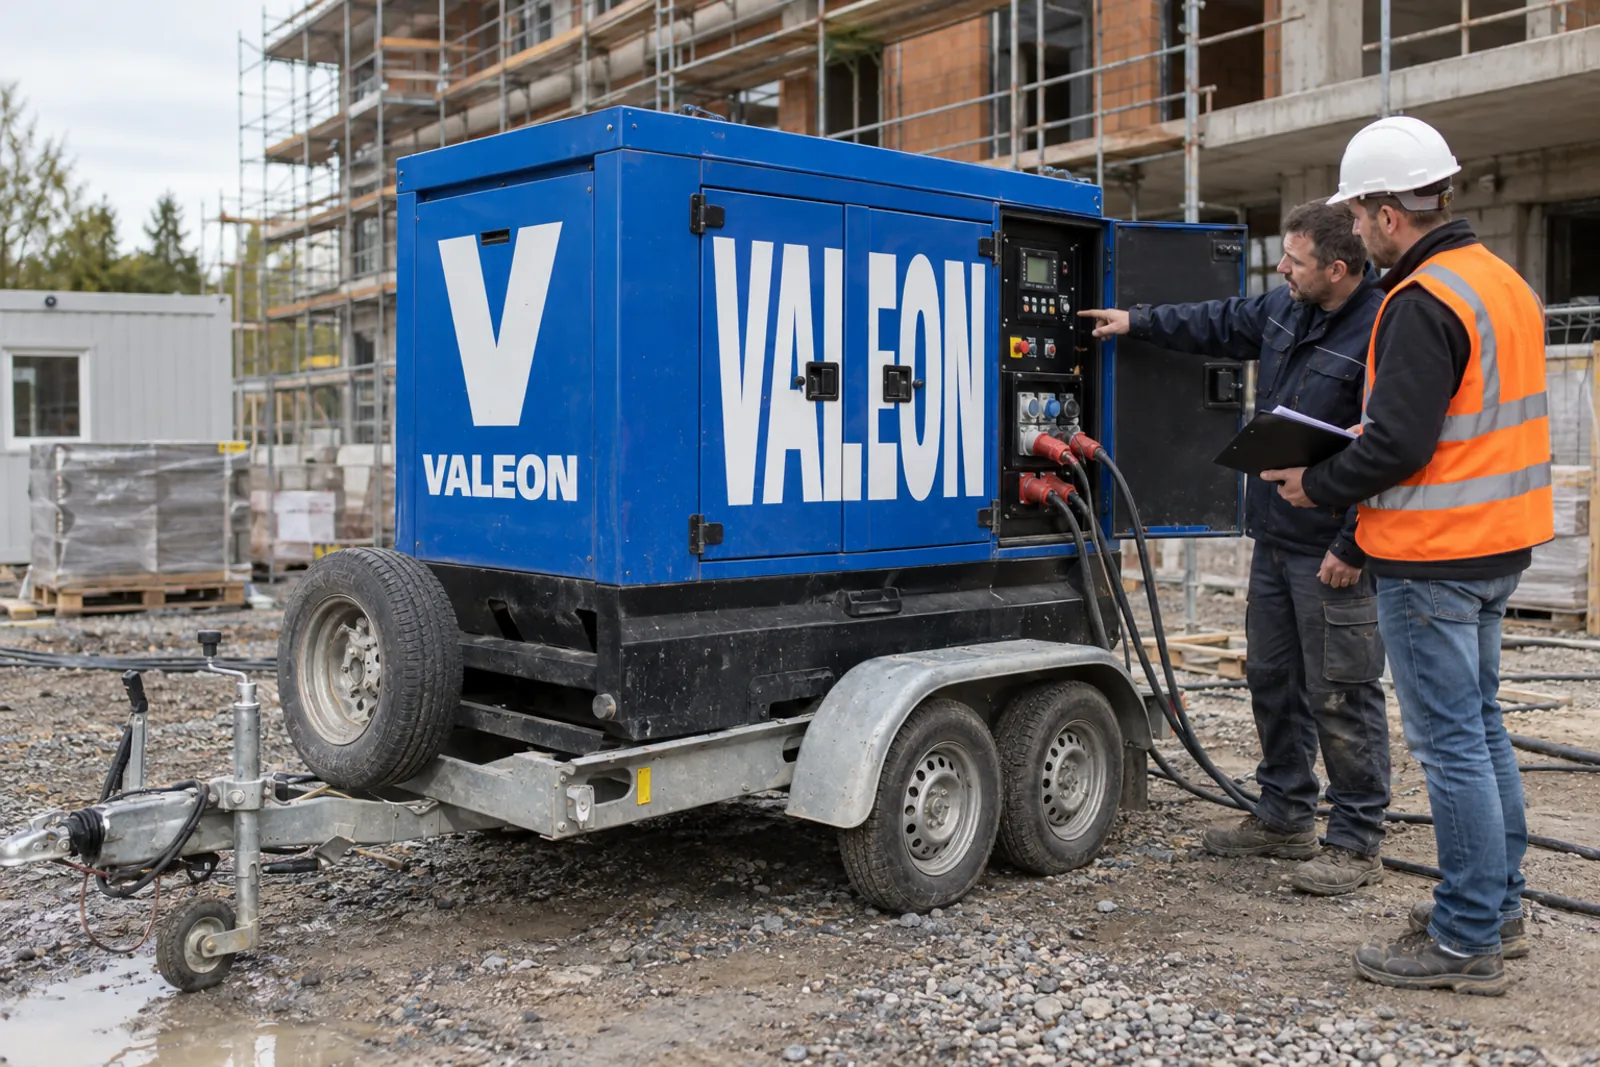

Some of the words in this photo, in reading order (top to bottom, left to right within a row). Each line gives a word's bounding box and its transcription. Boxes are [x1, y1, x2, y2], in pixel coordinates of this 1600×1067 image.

[438, 221, 563, 426] V
[713, 236, 986, 506] VALEON
[423, 454, 578, 502] VALEON
